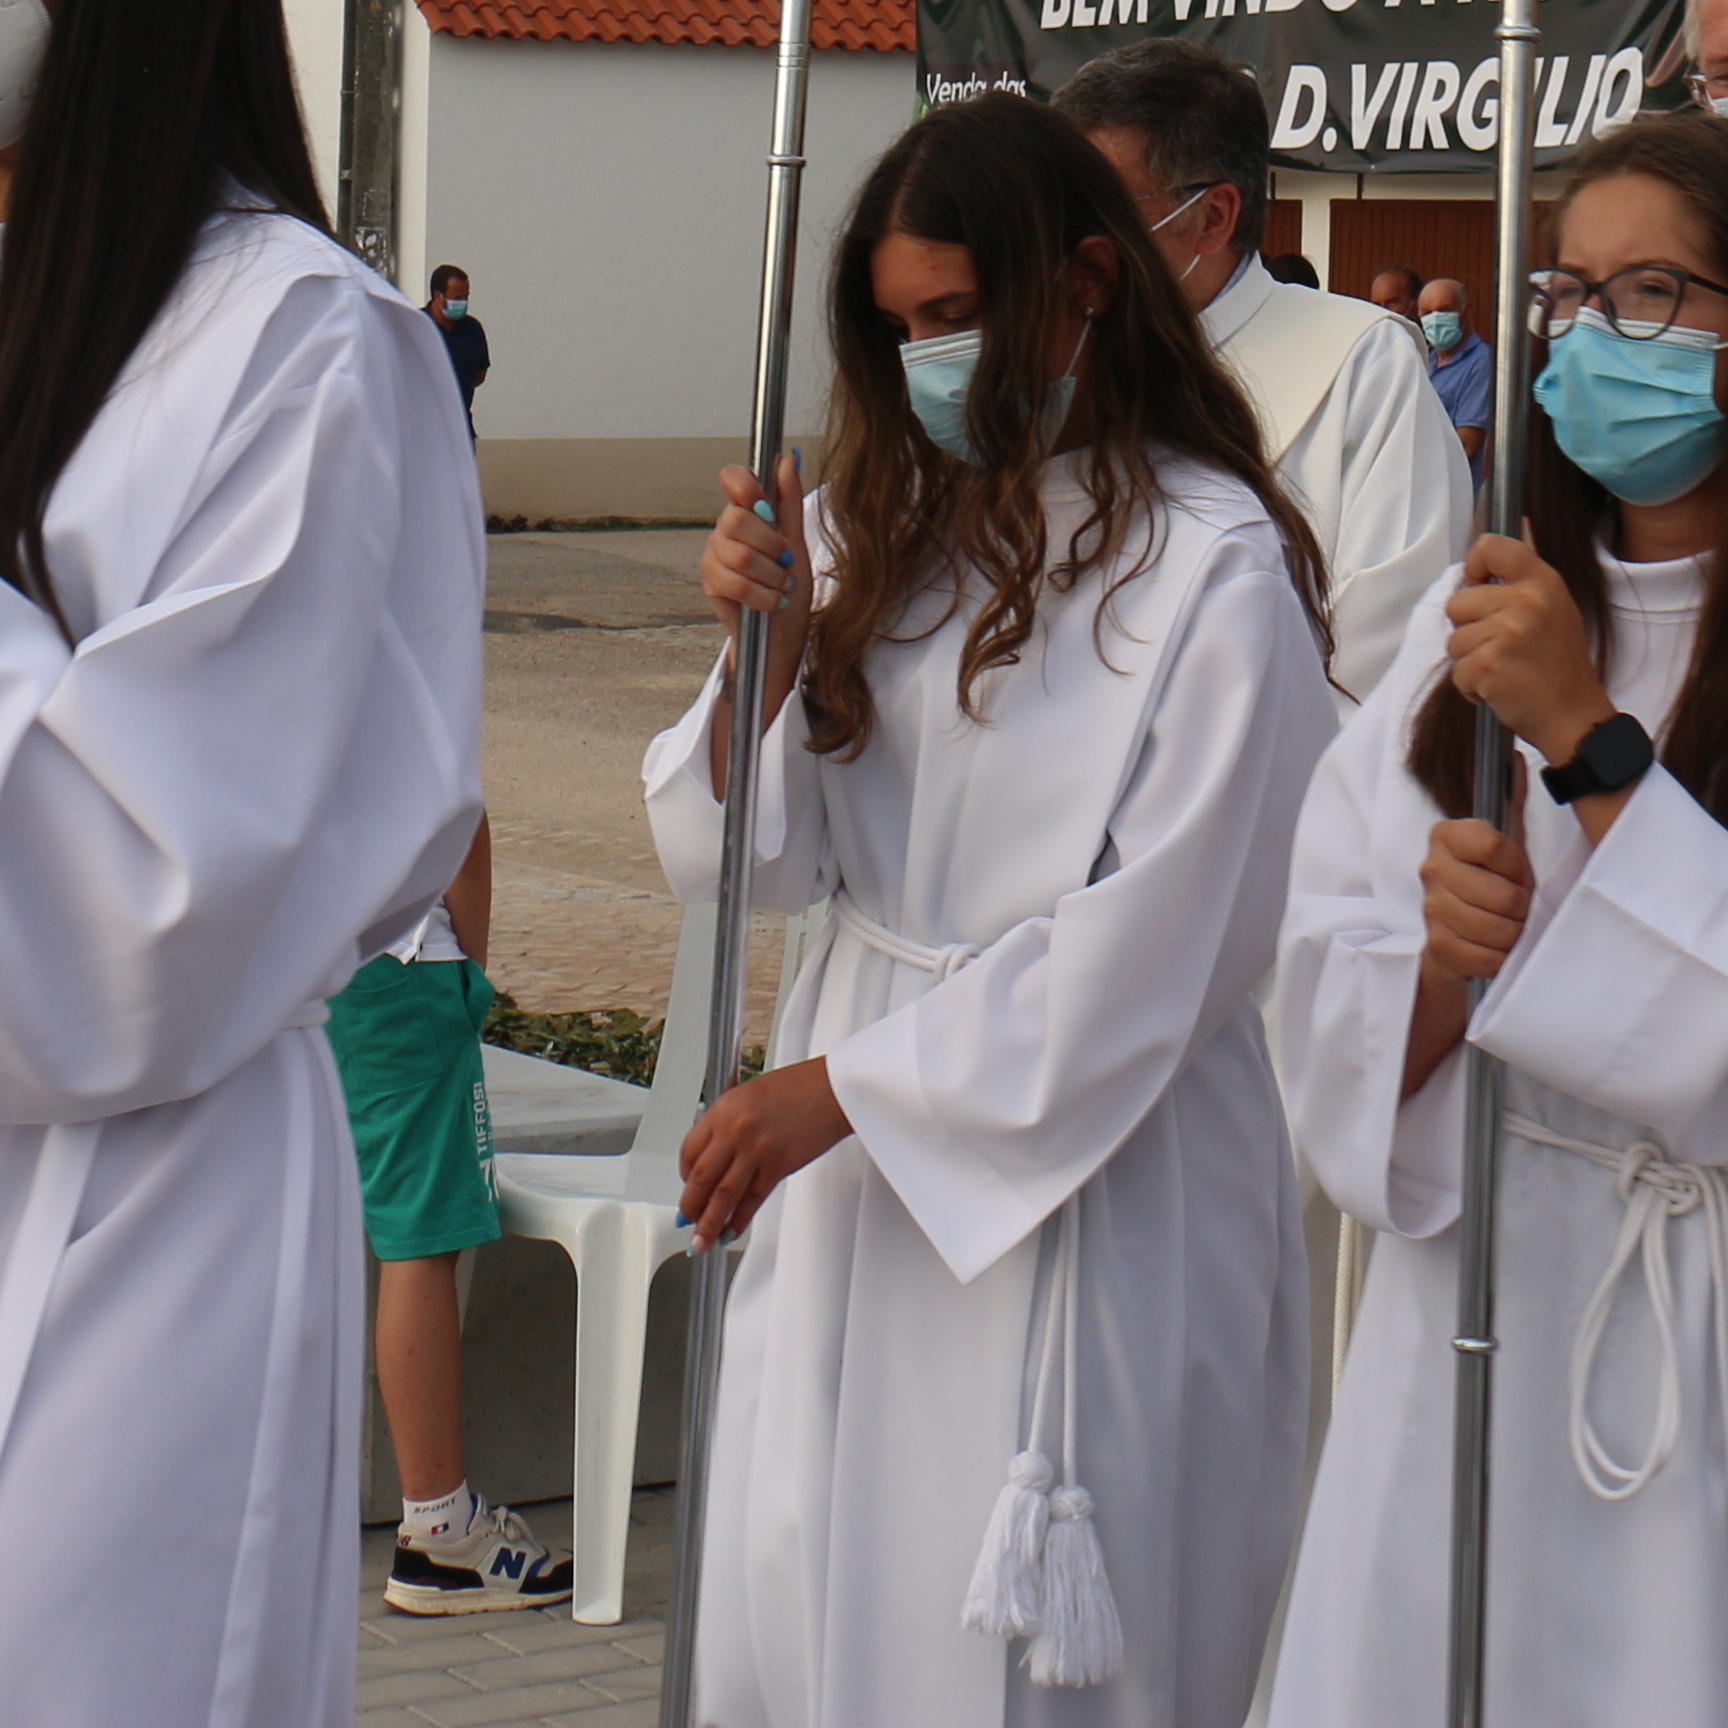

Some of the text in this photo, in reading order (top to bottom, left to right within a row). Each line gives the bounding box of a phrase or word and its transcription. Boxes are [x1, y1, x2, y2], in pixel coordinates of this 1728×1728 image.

[1270, 47, 1643, 152] D.VIRGLIO
[473, 1082, 488, 1155] TIFFOSI
[413, 1499, 456, 1514] SPORT
[489, 1547, 526, 1580] N
